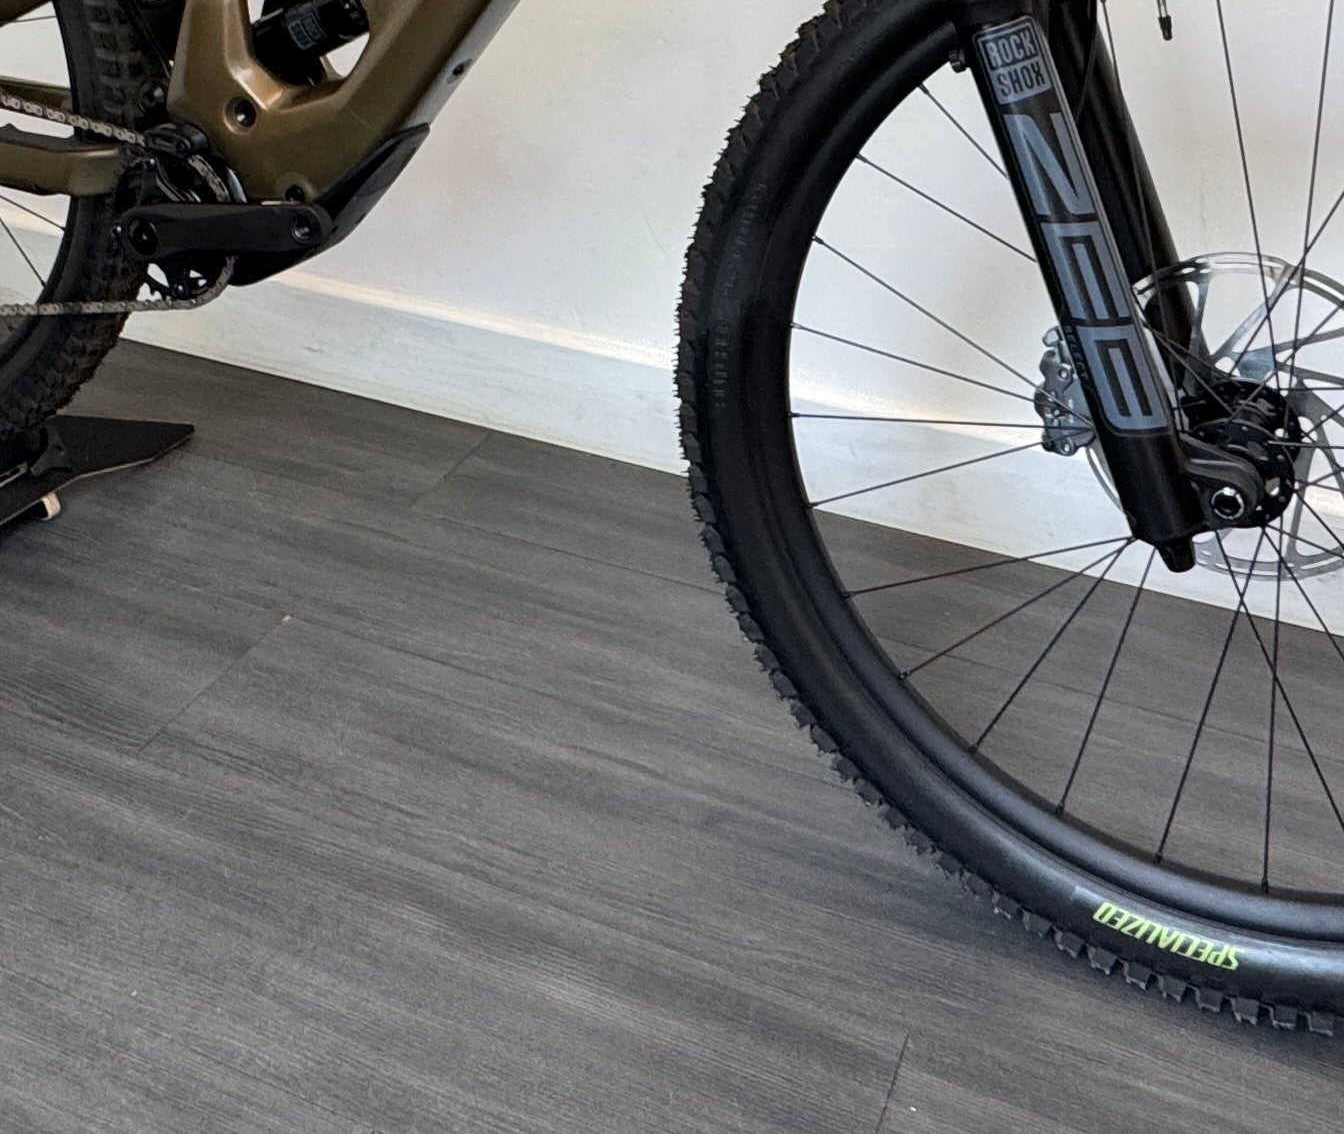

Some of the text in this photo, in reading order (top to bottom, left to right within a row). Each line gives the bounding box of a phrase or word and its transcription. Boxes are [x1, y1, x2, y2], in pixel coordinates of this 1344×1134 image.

[985, 28, 1036, 68] ROCK
[996, 61, 1046, 97] SHOX
[1092, 901, 1245, 971] SPECIALIZED
